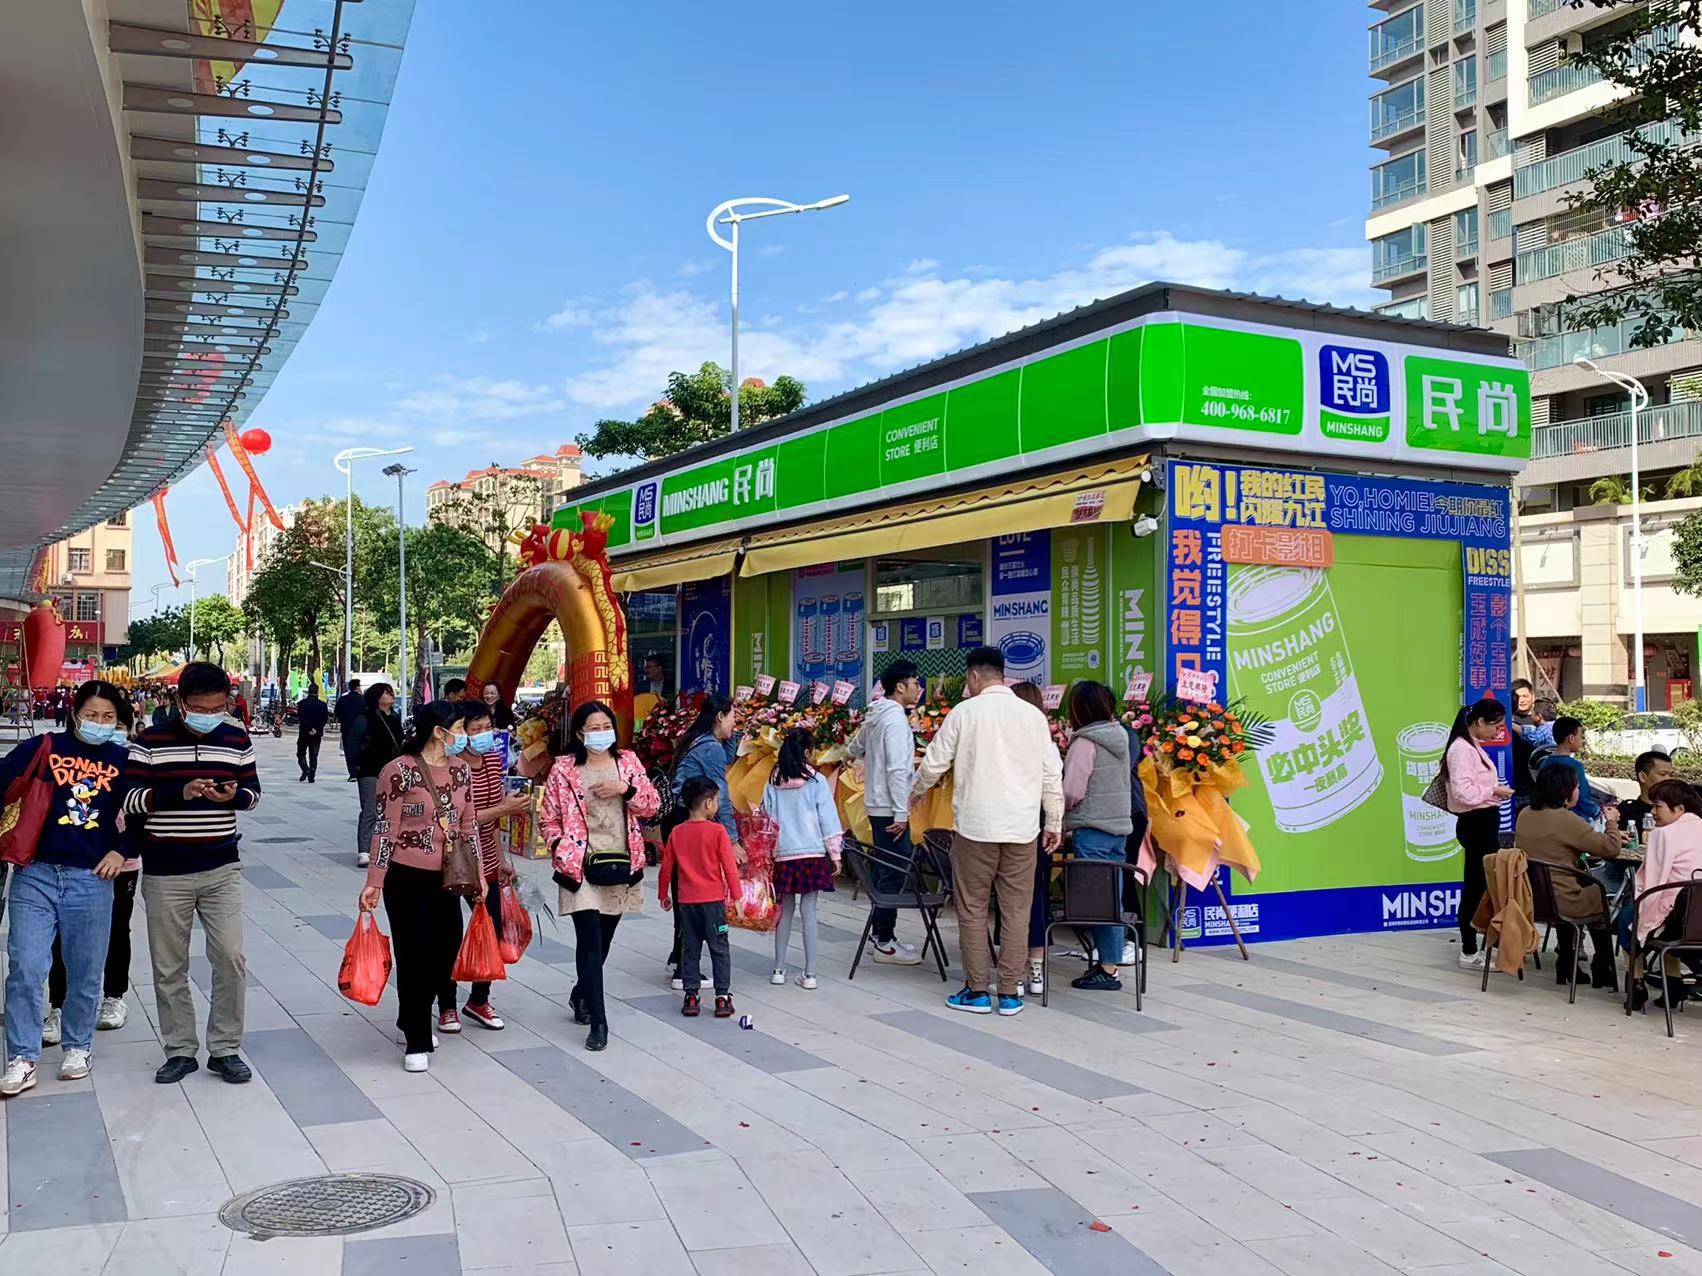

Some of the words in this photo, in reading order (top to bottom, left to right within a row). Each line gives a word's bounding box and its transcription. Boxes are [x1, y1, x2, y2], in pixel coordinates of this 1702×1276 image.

[1331, 351, 1376, 378] MS
[1333, 375, 1378, 408] 民尚
[1421, 374, 1519, 438] 民尚
[1200, 400, 1291, 424] 400-968-6817
[885, 416, 940, 443] CONVENIENT
[1326, 420, 1383, 437] MINSHANG
[885, 443, 911, 461] STORE
[914, 435, 939, 454] 便利店
[662, 477, 729, 518] MINSHANG
[732, 457, 776, 506] 民尚
[1239, 469, 1326, 501] 我的红民
[1329, 484, 1435, 513] YO,HOMIE!
[1239, 496, 1328, 529] 闪耀九江
[1330, 507, 1415, 533] SHINING
[1420, 513, 1506, 538] JIUJIANG
[1229, 528, 1325, 563] 打卡影相
[1466, 546, 1511, 577] DISS
[1468, 576, 1511, 588] FREESTYLE
[993, 600, 1049, 618] MINSHANG
[1233, 611, 1335, 671] MINSHANG
[1260, 650, 1319, 684] CONVENIENT
[1265, 676, 1298, 694] STORE
[1266, 709, 1366, 785] 必中头奖
[48, 753, 120, 778] DONALD
[53, 767, 112, 792] DUCK
